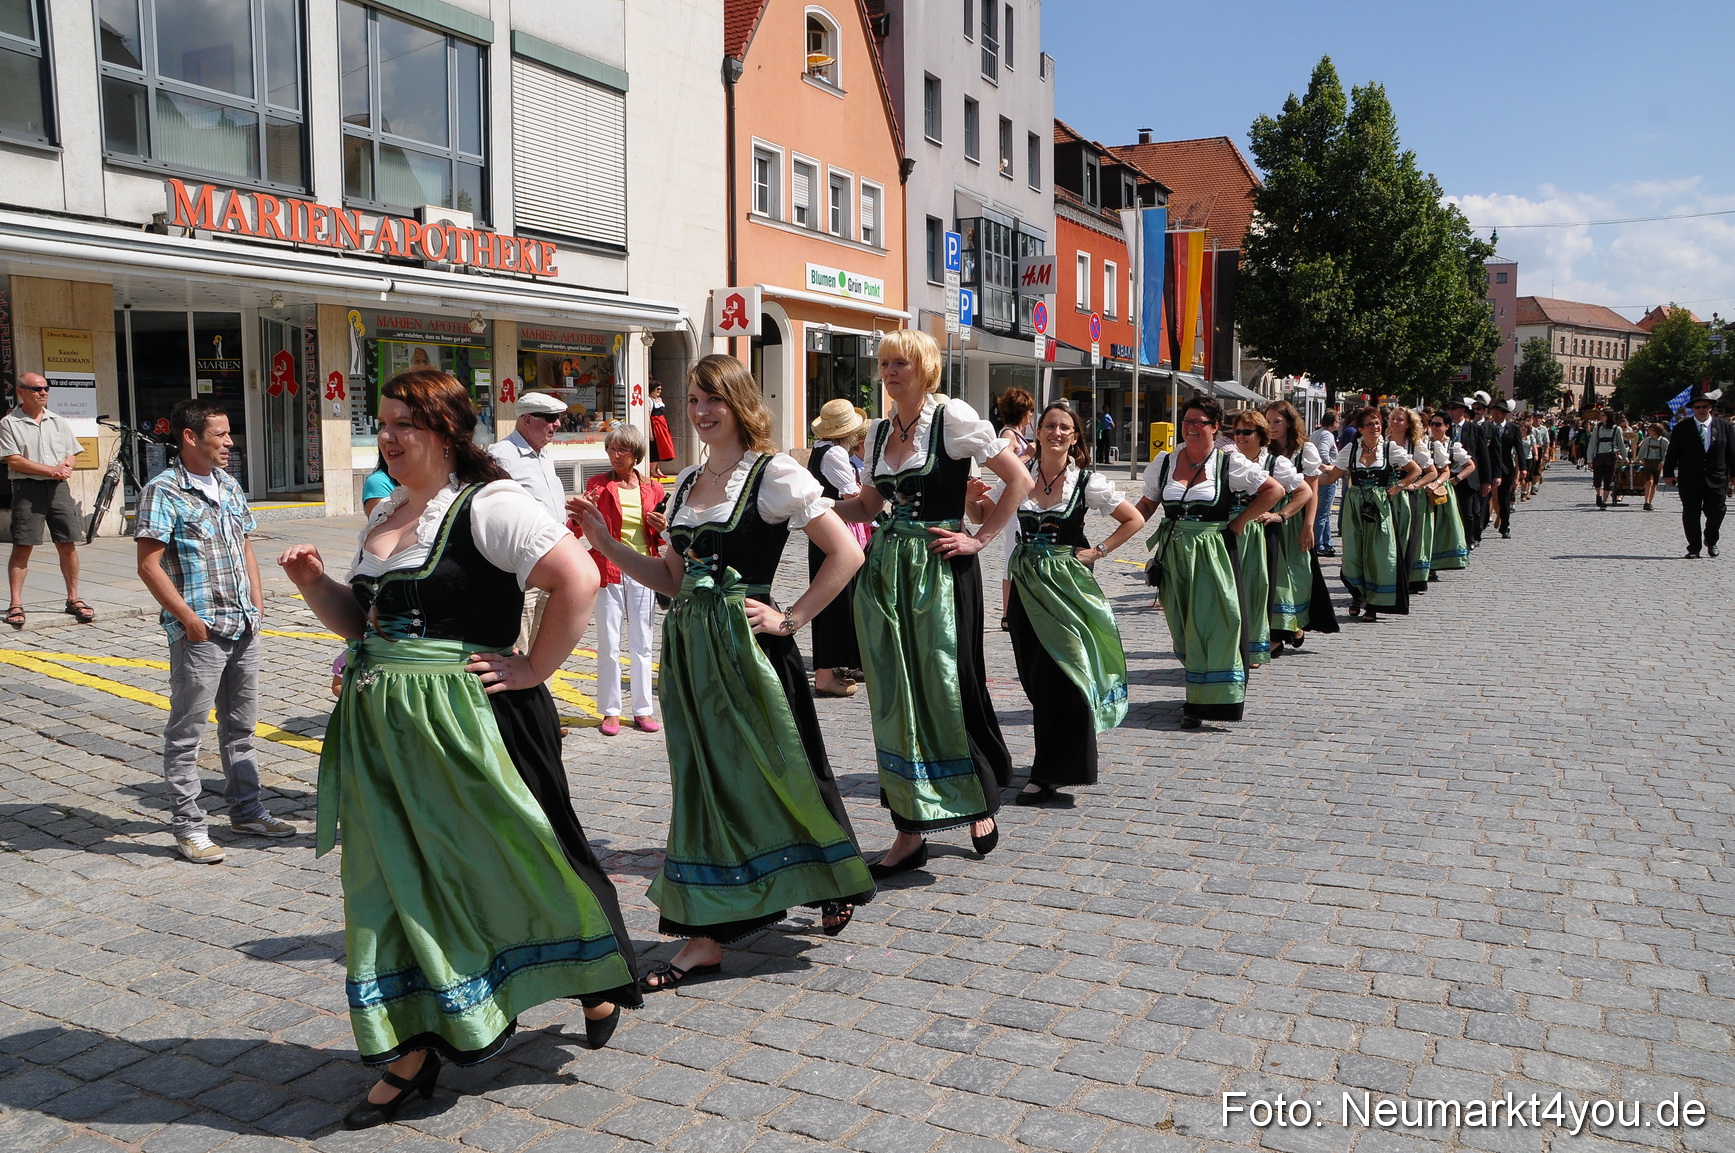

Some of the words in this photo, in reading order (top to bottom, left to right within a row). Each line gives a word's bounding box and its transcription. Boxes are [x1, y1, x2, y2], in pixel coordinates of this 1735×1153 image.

[166, 178, 559, 278] MARIEN-APOTHEKE
[948, 236, 958, 266] P
[811, 269, 836, 289] Blumen
[847, 277, 862, 294] Grün
[863, 281, 881, 298] Punkt
[1021, 263, 1053, 287] H&M
[961, 293, 970, 321] P
[376, 315, 422, 330] MARIEN
[427, 320, 486, 335] APOTHE
[521, 328, 557, 341] MARIEN
[560, 332, 607, 345] APOTHEKE
[47, 356, 91, 364] KELLERMANN
[304, 316, 317, 384] MARIEN
[197, 361, 240, 370] MARIEN
[305, 386, 320, 482] APOTHEKE
